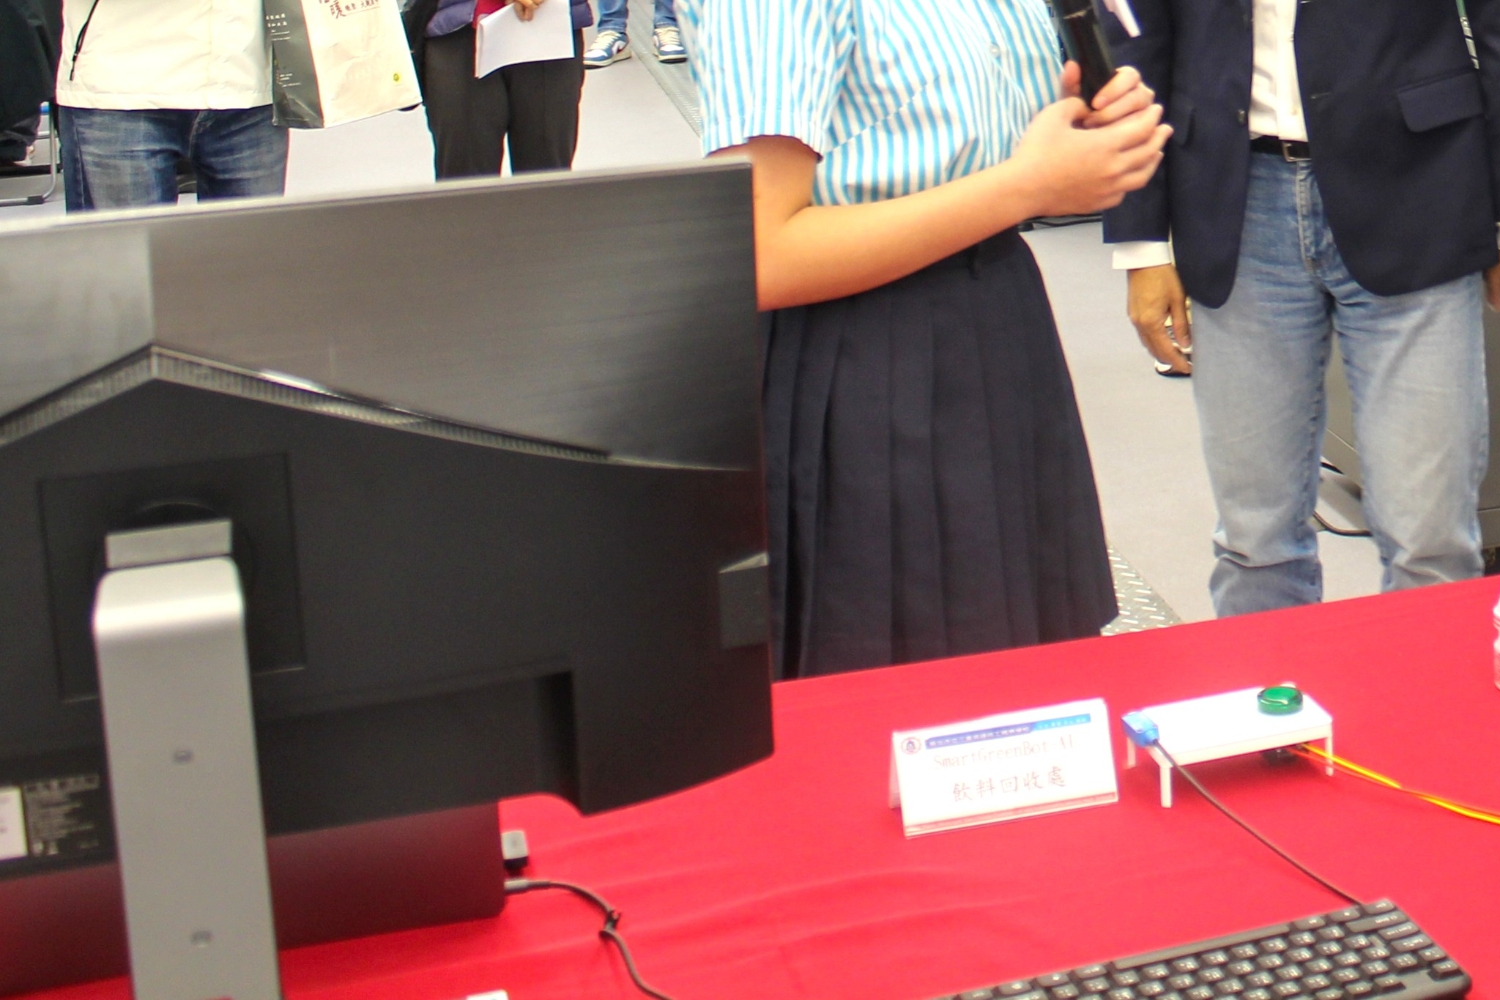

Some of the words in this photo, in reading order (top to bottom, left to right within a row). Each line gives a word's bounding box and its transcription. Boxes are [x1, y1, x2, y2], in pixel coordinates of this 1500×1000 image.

[952, 765, 1067, 802] 飲料回收處
